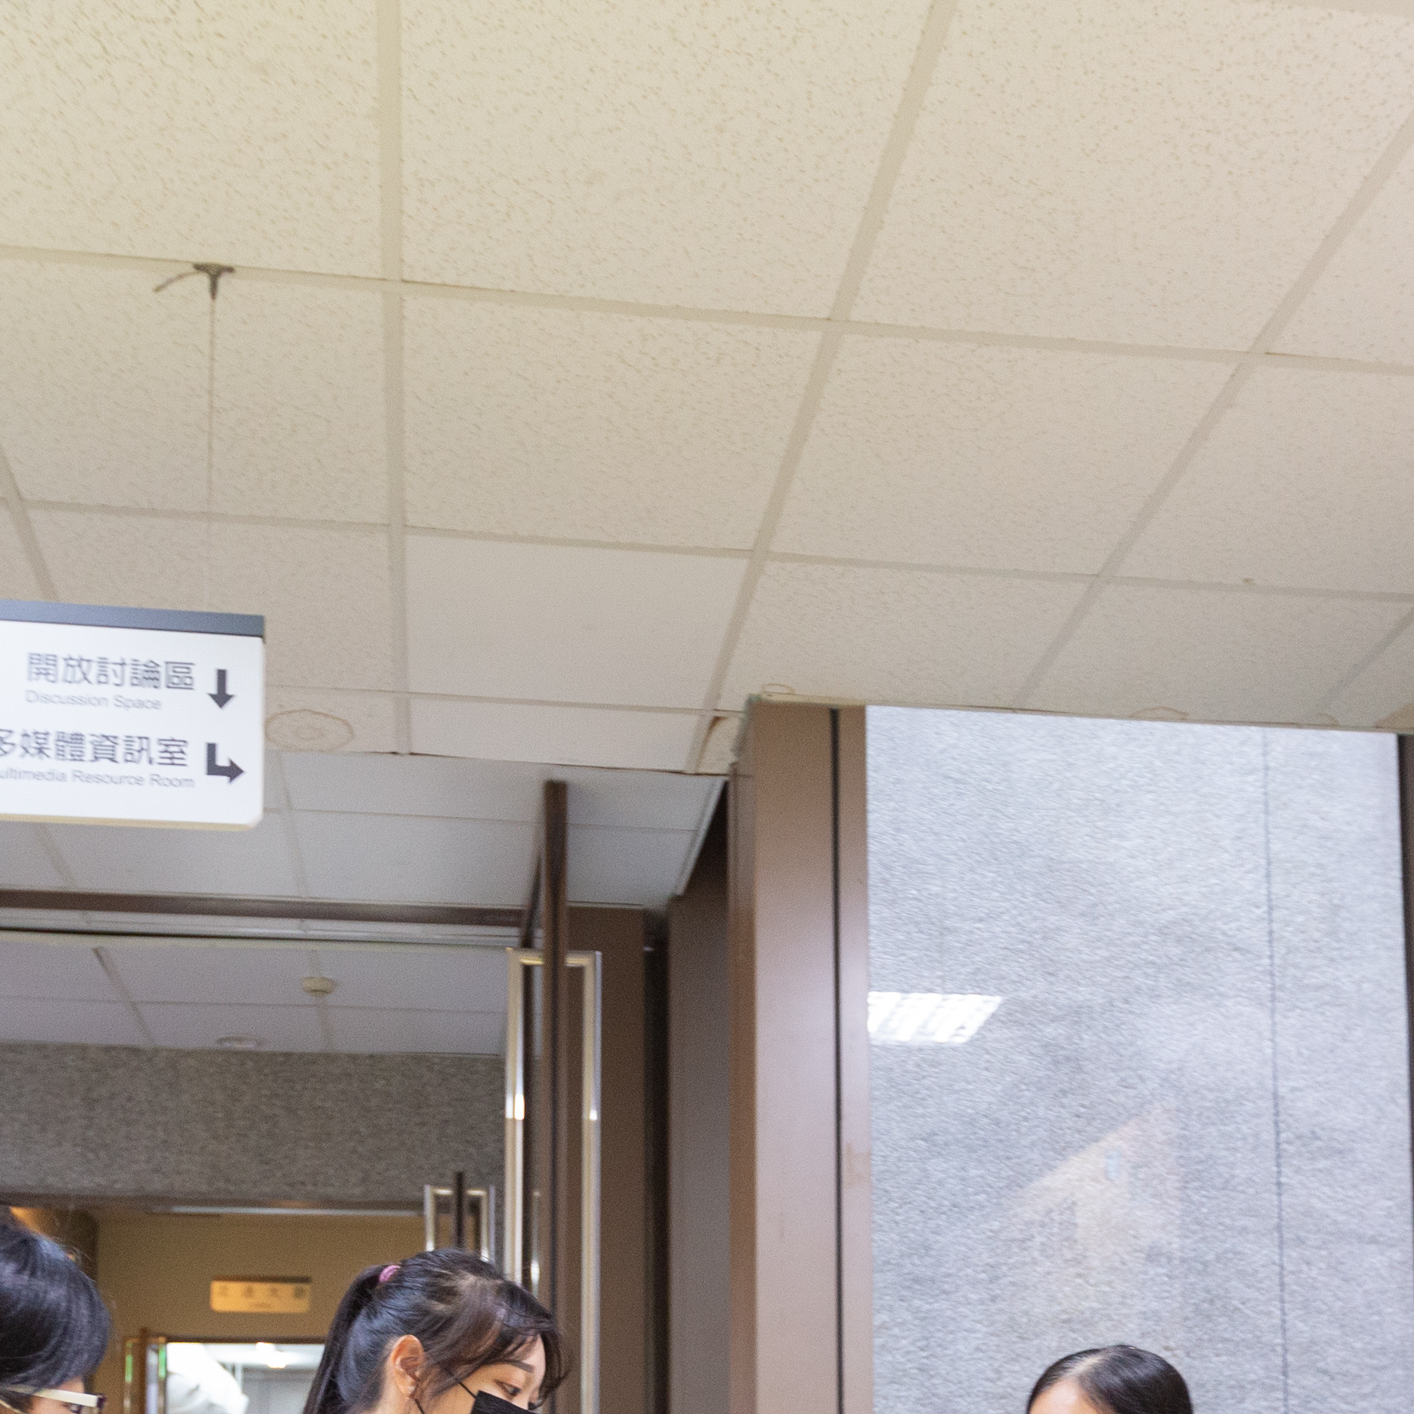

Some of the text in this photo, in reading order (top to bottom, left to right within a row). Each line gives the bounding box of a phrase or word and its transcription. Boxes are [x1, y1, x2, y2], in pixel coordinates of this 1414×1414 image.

[27, 652, 196, 690] 開放討論區
[25, 689, 162, 711] Discussion Space
[71, 768, 146, 787] Resource
[149, 772, 196, 788] Room
